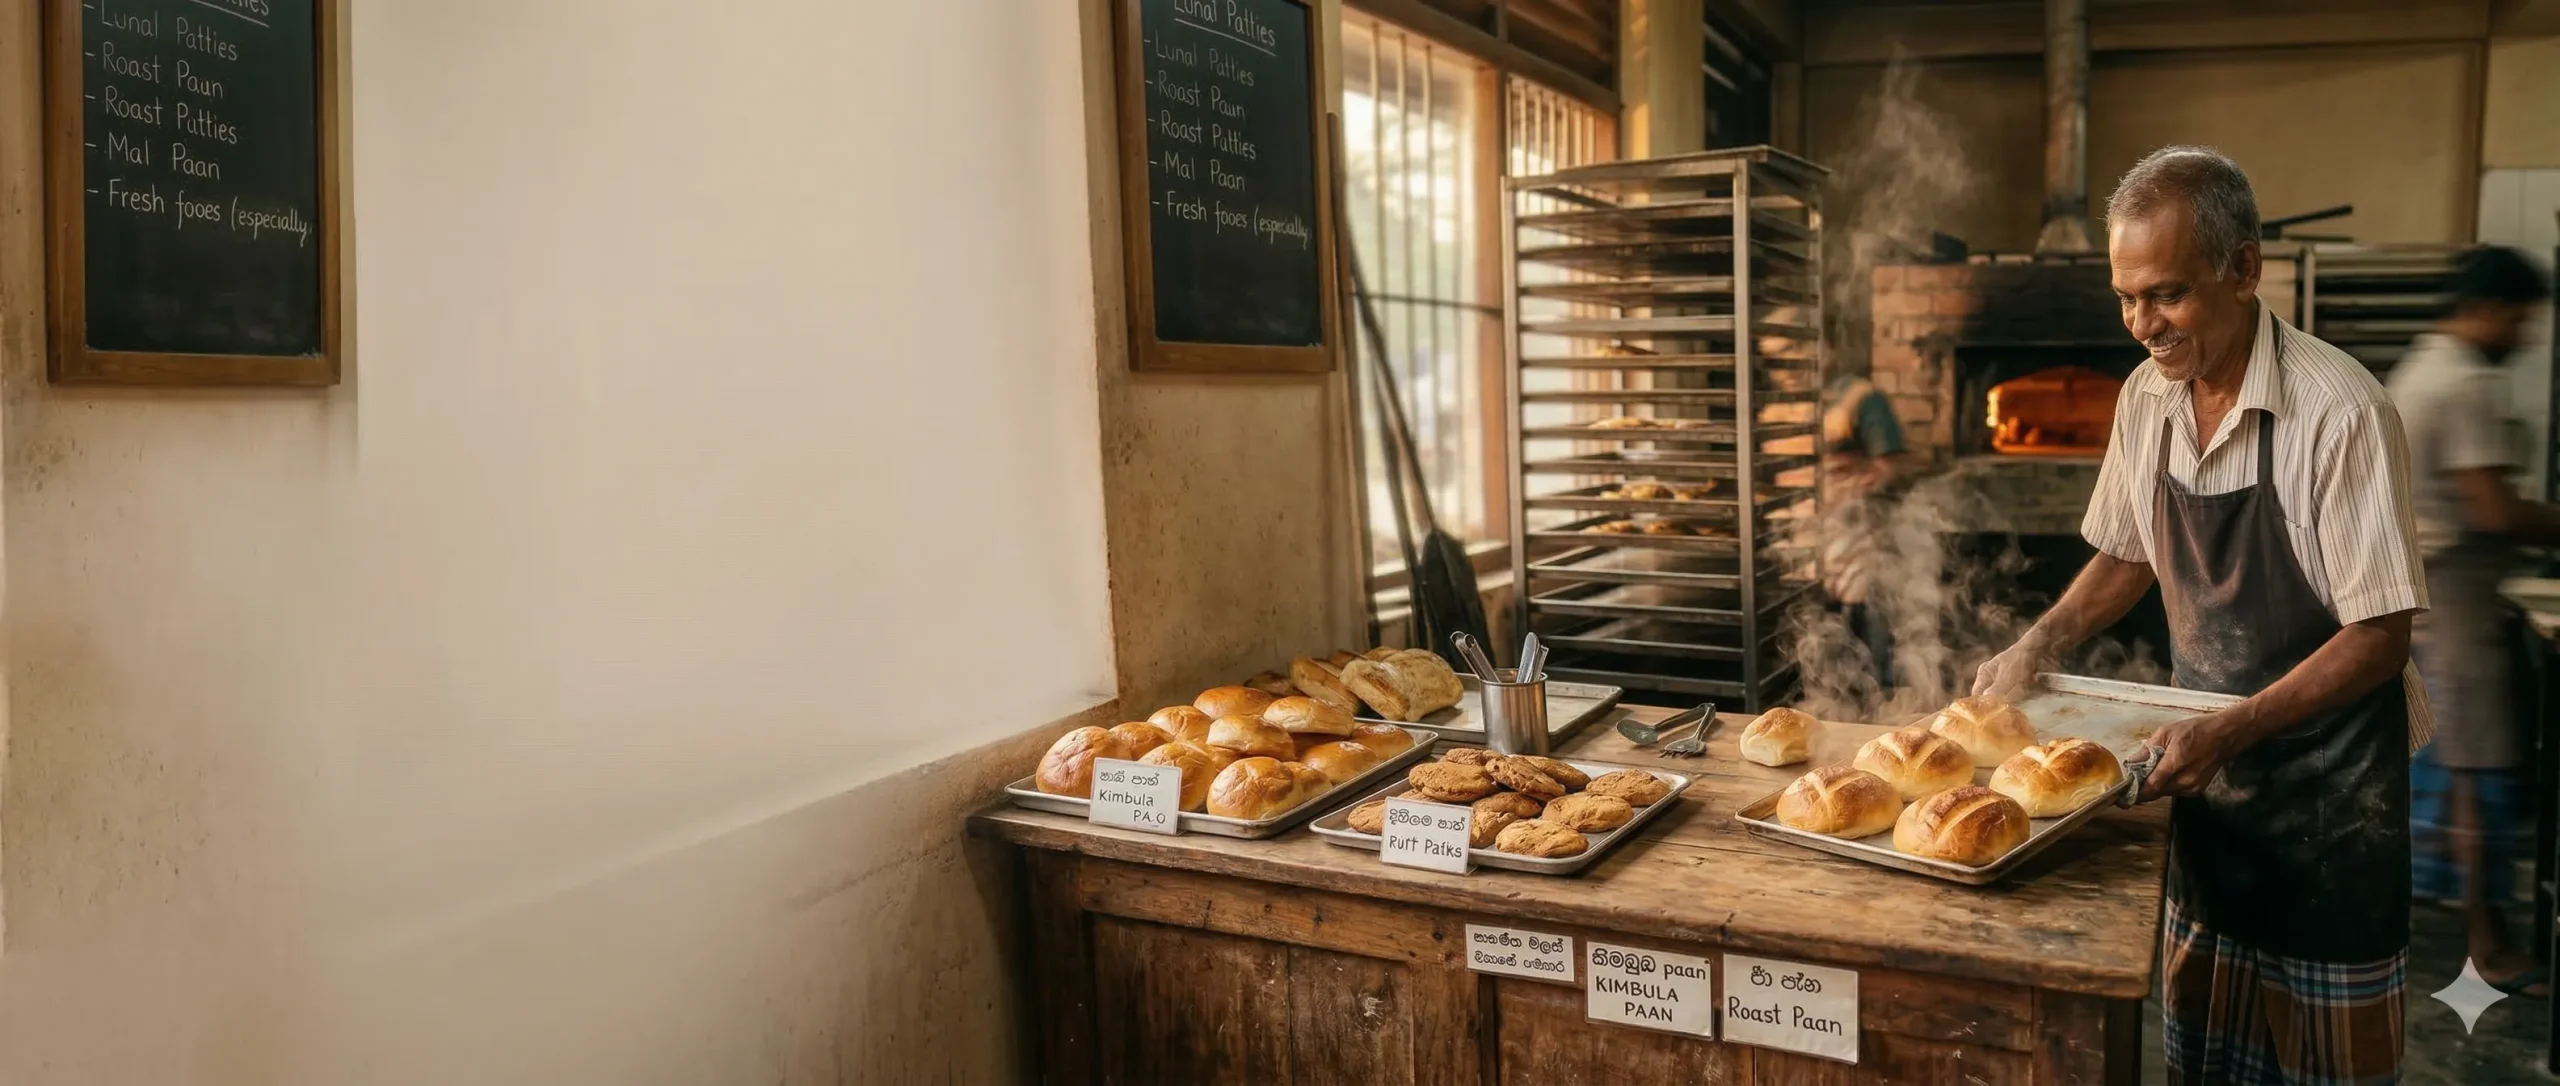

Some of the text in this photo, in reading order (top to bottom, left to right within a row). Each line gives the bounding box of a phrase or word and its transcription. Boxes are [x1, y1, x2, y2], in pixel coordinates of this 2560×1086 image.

[101, 0, 238, 61] Lunal Patties
[1227, 0, 1276, 46] Patties
[103, 41, 162, 84] Roast
[1155, 30, 1255, 87] Lunal Patties
[105, 85, 163, 125] Roast
[1158, 69, 1200, 107] Roast
[1161, 109, 1203, 144] Roast
[108, 131, 221, 181] Mal Paan
[1164, 150, 1246, 192] Mal Paan
[109, 178, 164, 213] Fresh
[1167, 190, 1207, 222] Fresh
[1099, 789, 1154, 807] Kimbula
[1595, 976, 1679, 1003] KIMBULA
[1664, 963, 1706, 980] paan
[1625, 1002, 1673, 1023] PAAN
[1728, 995, 1843, 1037] Roast Paan
